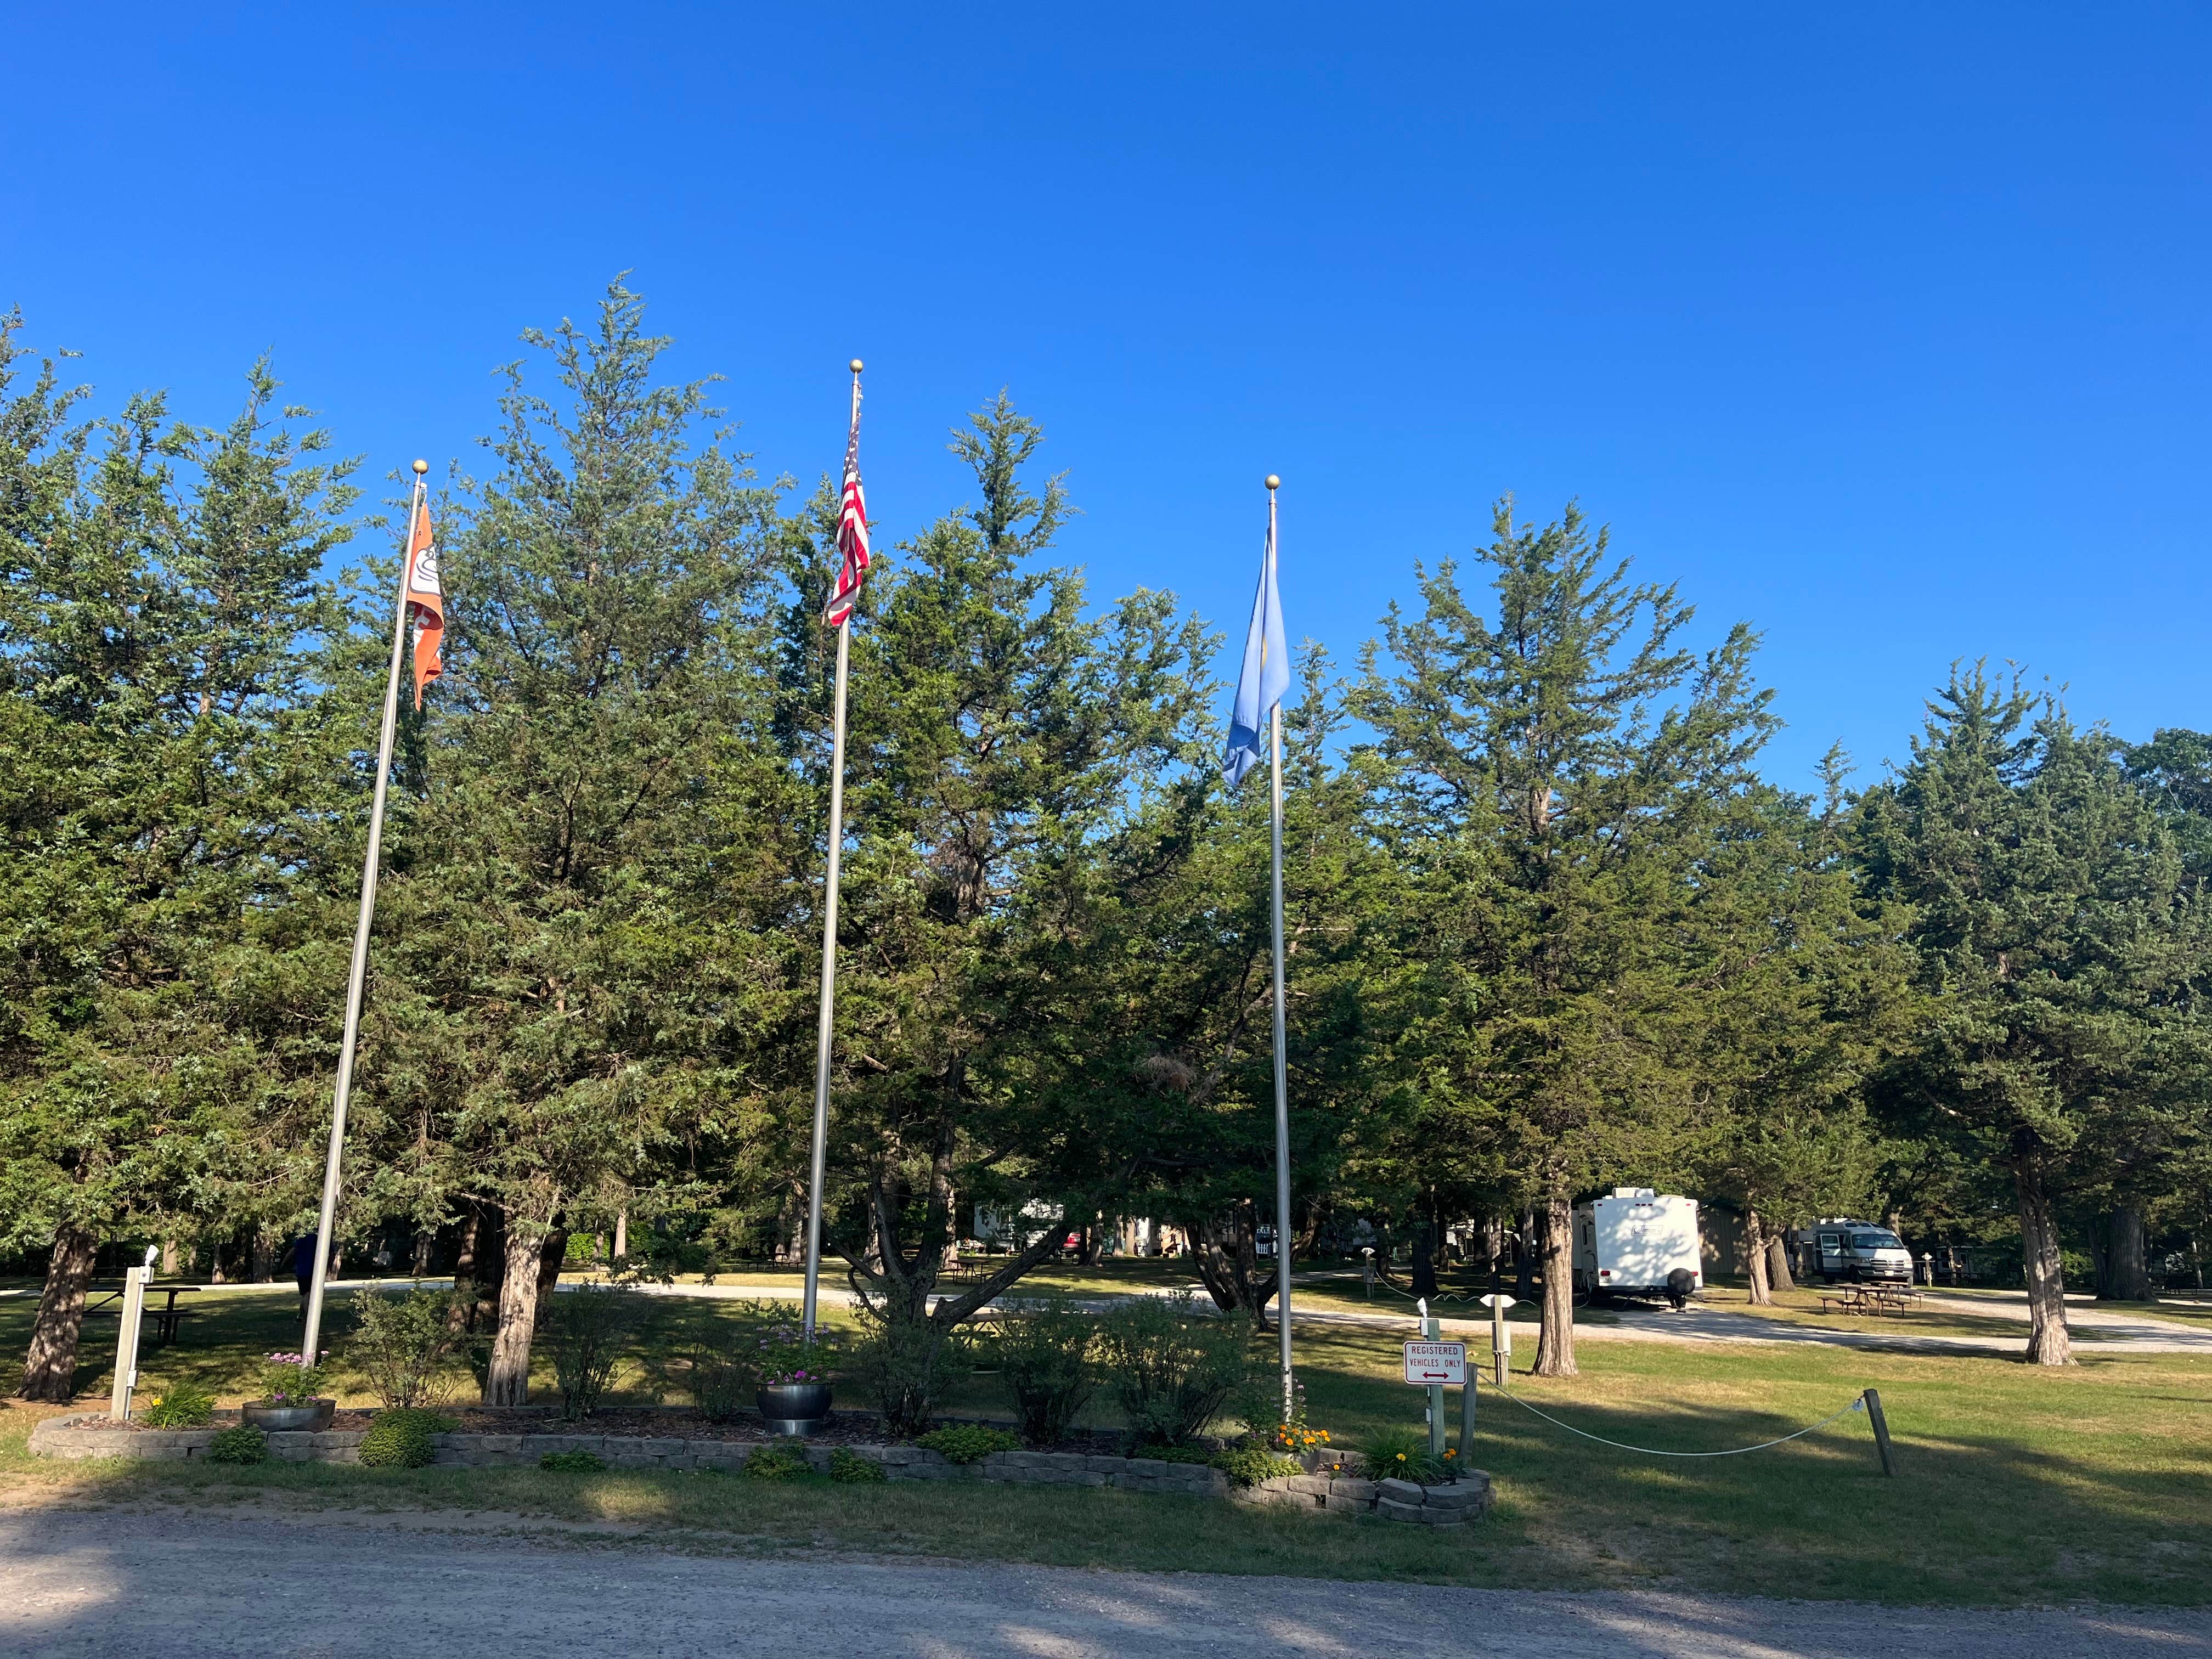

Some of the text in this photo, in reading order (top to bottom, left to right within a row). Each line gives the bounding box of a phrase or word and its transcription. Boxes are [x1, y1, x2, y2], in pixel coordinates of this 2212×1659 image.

[1412, 1346, 1458, 1355] REGISTERED
[1410, 1358, 1461, 1368] VEHICLES ONLY
